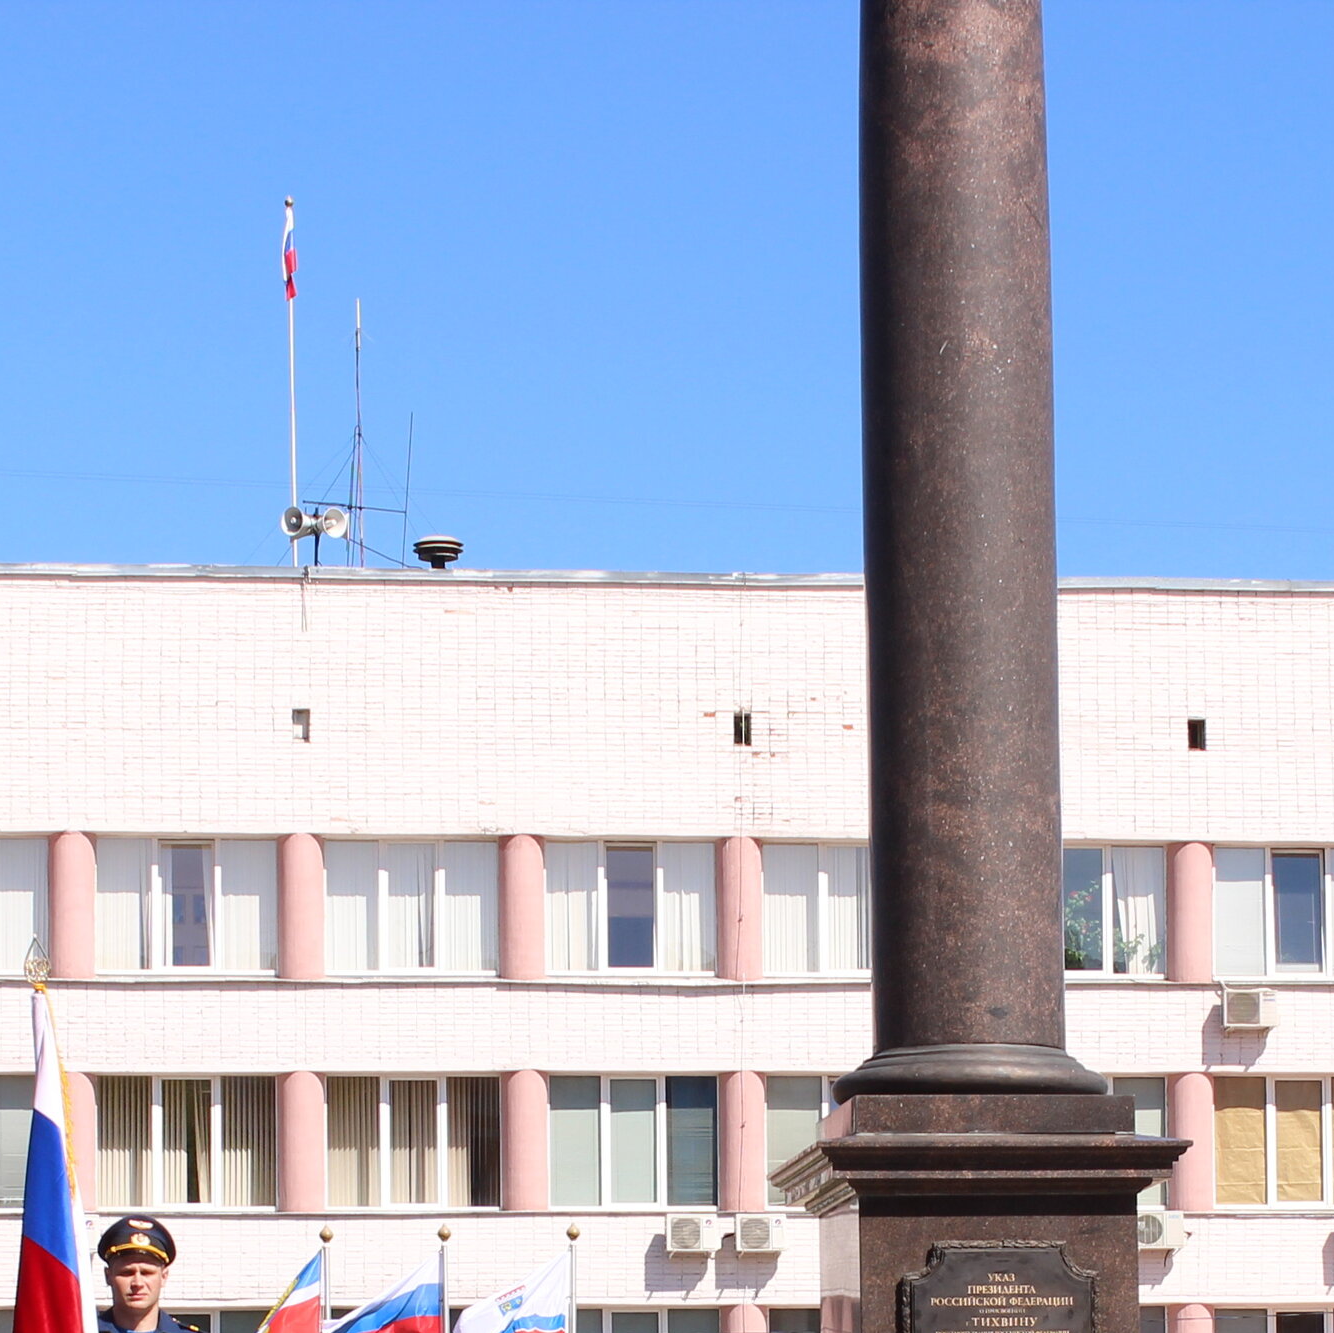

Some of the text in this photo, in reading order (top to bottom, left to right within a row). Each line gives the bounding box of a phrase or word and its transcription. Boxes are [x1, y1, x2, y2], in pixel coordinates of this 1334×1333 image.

[988, 1273, 1015, 1282] УКАЗ
[967, 1285, 1036, 1294] ПРЕЗИДЕНТА
[930, 1296, 1074, 1307] РОССИЙСКОЙ ФЕДЕРАЦИИ
[971, 1316, 1038, 1327] ТИХВИНУ
